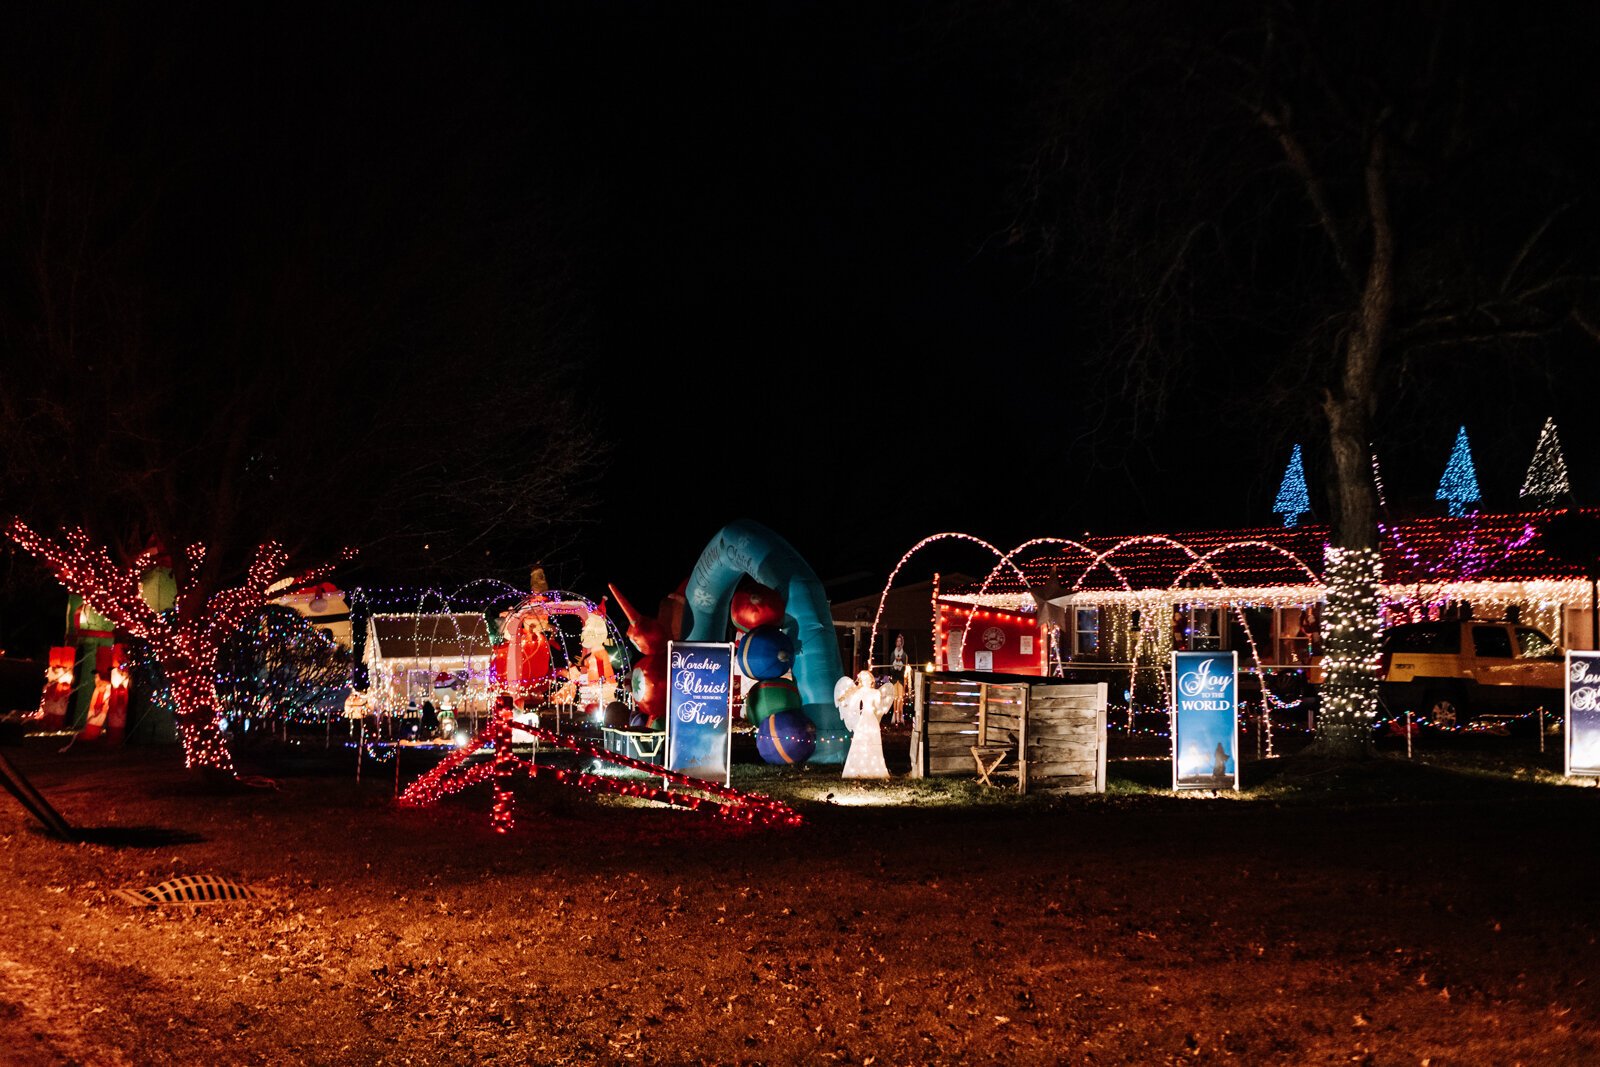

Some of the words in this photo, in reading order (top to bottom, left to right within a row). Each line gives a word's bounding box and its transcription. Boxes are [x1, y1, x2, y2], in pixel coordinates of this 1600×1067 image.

[726, 544, 761, 580] Christ
[671, 651, 722, 674] Worship
[674, 670, 728, 696] Christ
[1178, 658, 1233, 697] Joy
[677, 700, 724, 729] King
[1181, 700, 1230, 711] WORLD
